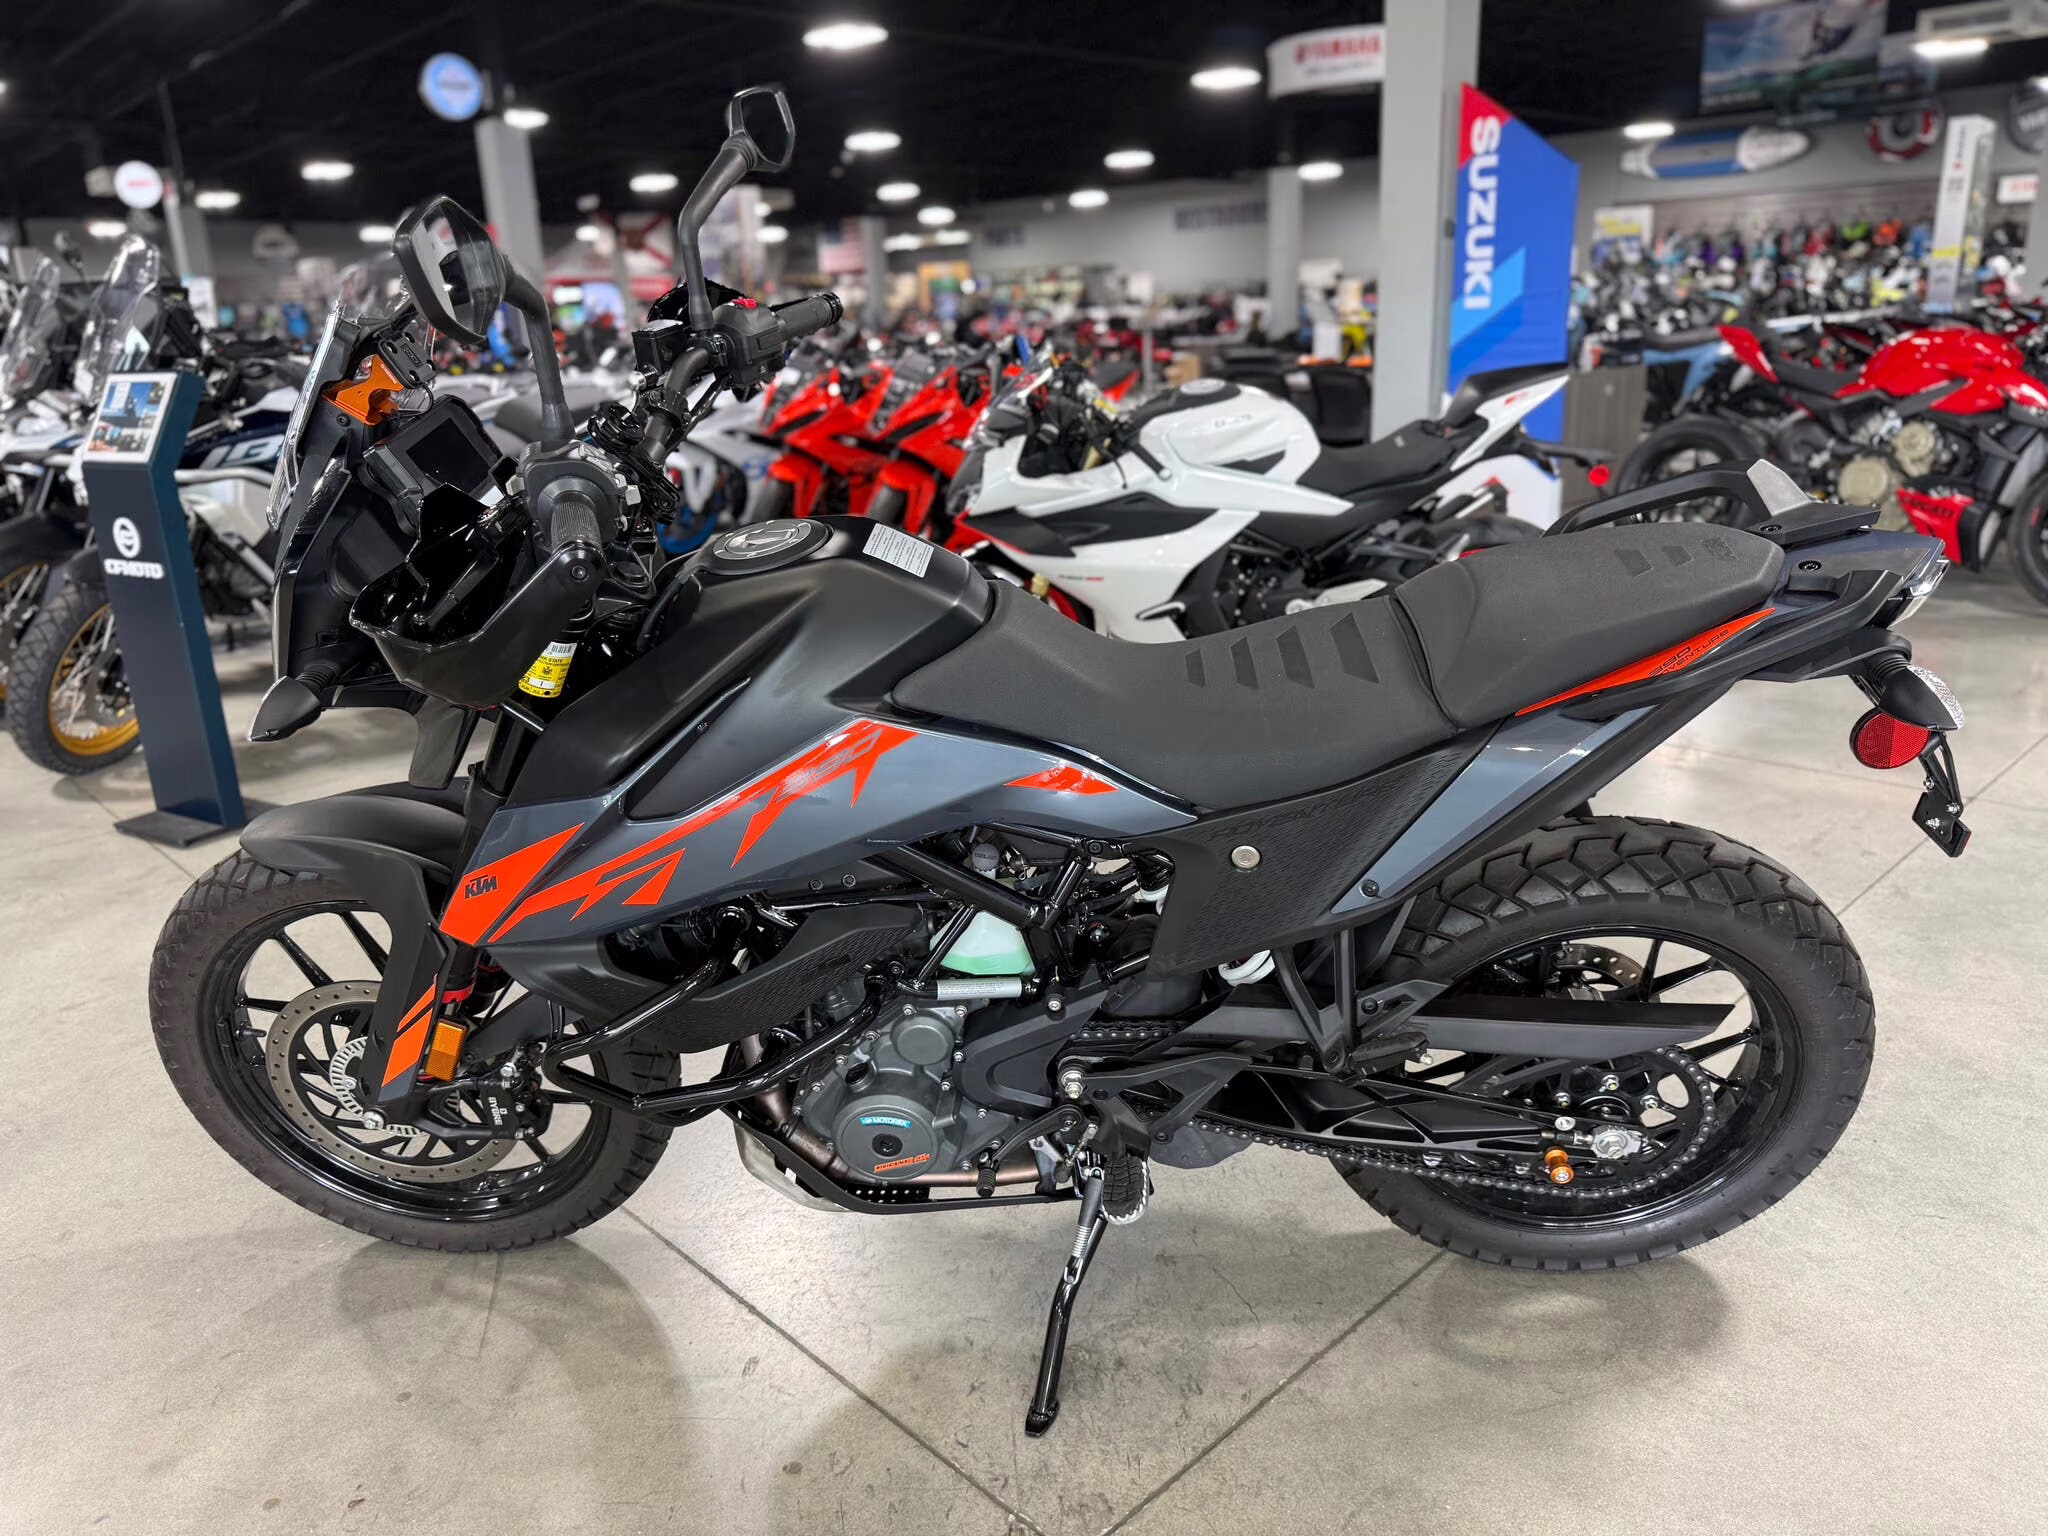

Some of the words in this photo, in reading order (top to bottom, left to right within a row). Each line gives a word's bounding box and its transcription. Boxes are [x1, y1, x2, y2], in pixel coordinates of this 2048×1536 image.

[1464, 115, 1501, 310] SUZUKI
[464, 875, 498, 899] KTM
[488, 1096, 503, 1127] BYBRE
